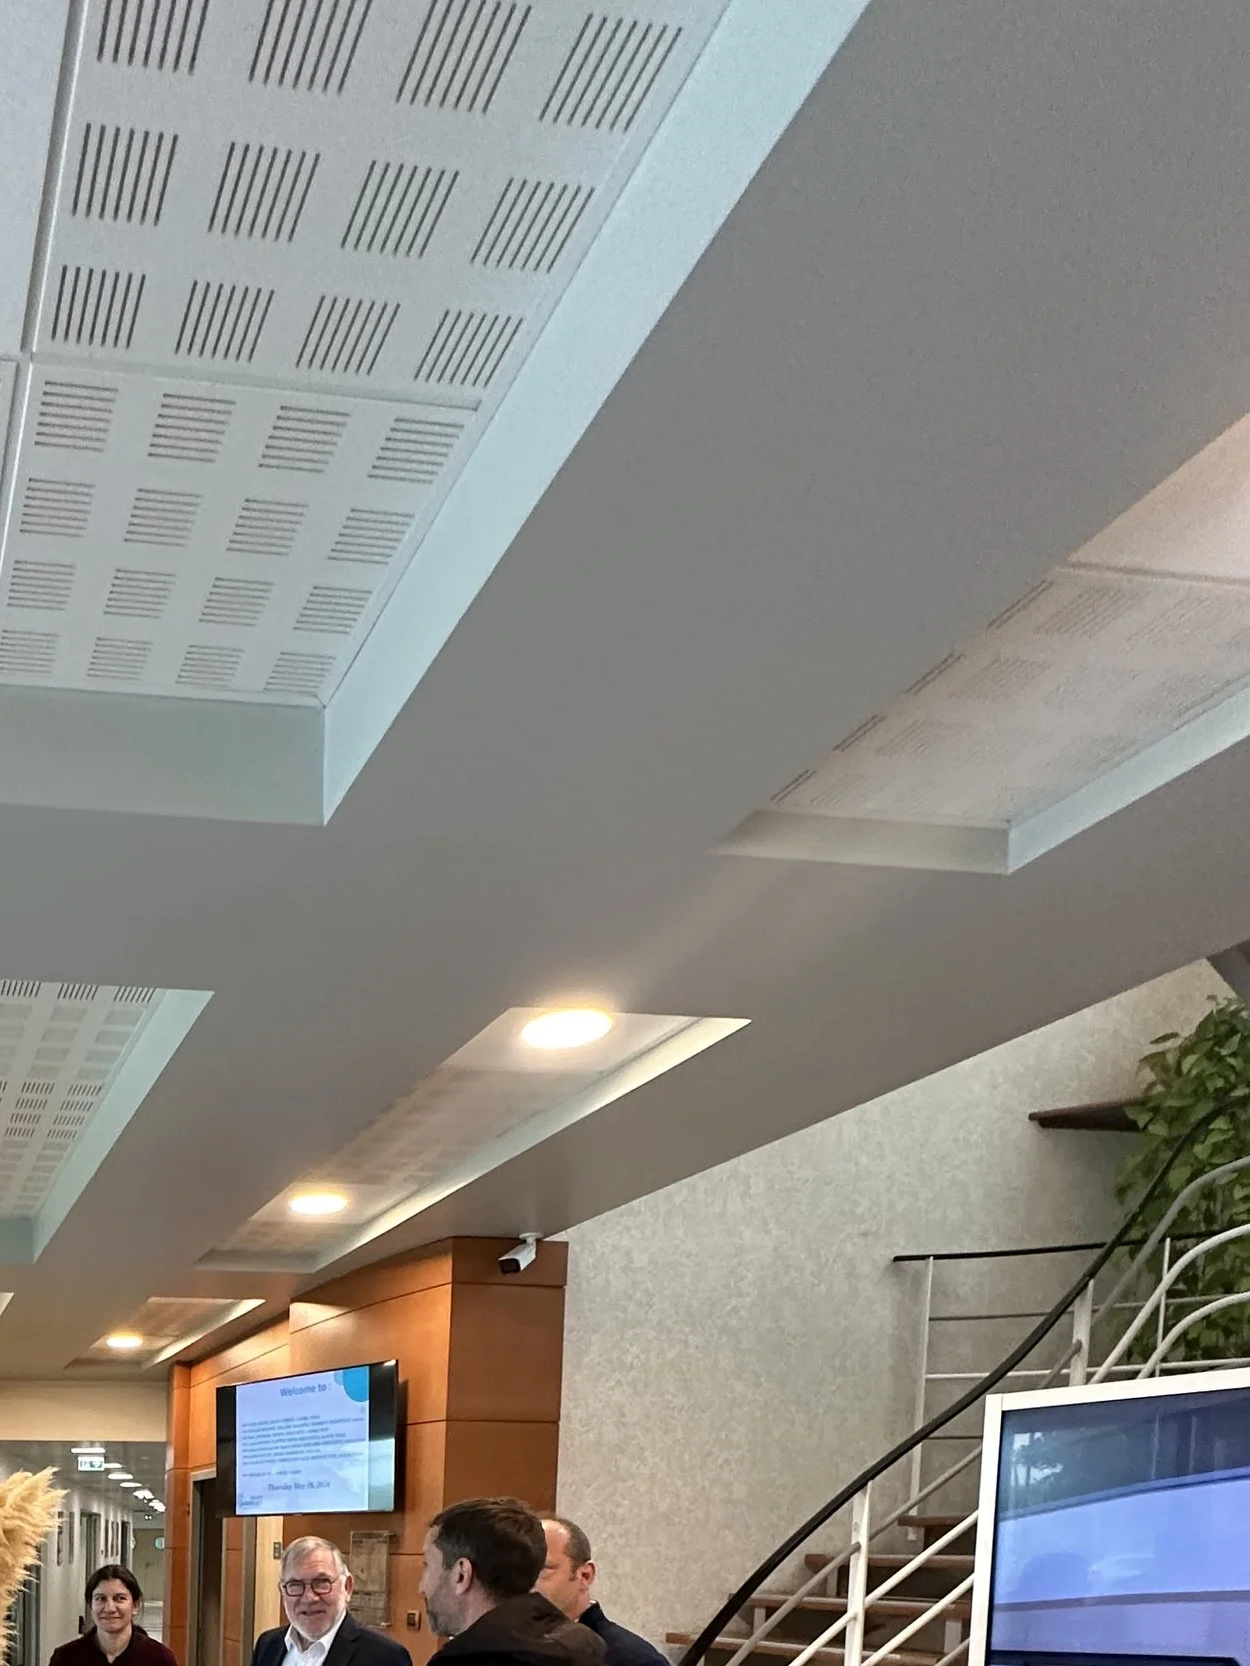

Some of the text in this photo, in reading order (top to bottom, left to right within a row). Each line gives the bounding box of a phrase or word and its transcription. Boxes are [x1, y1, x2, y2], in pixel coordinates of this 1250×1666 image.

[280, 1385, 316, 1397] Welcome
[317, 1383, 327, 1392] to
[268, 1483, 292, 1491] Thursday
[293, 1482, 306, 1490] May
